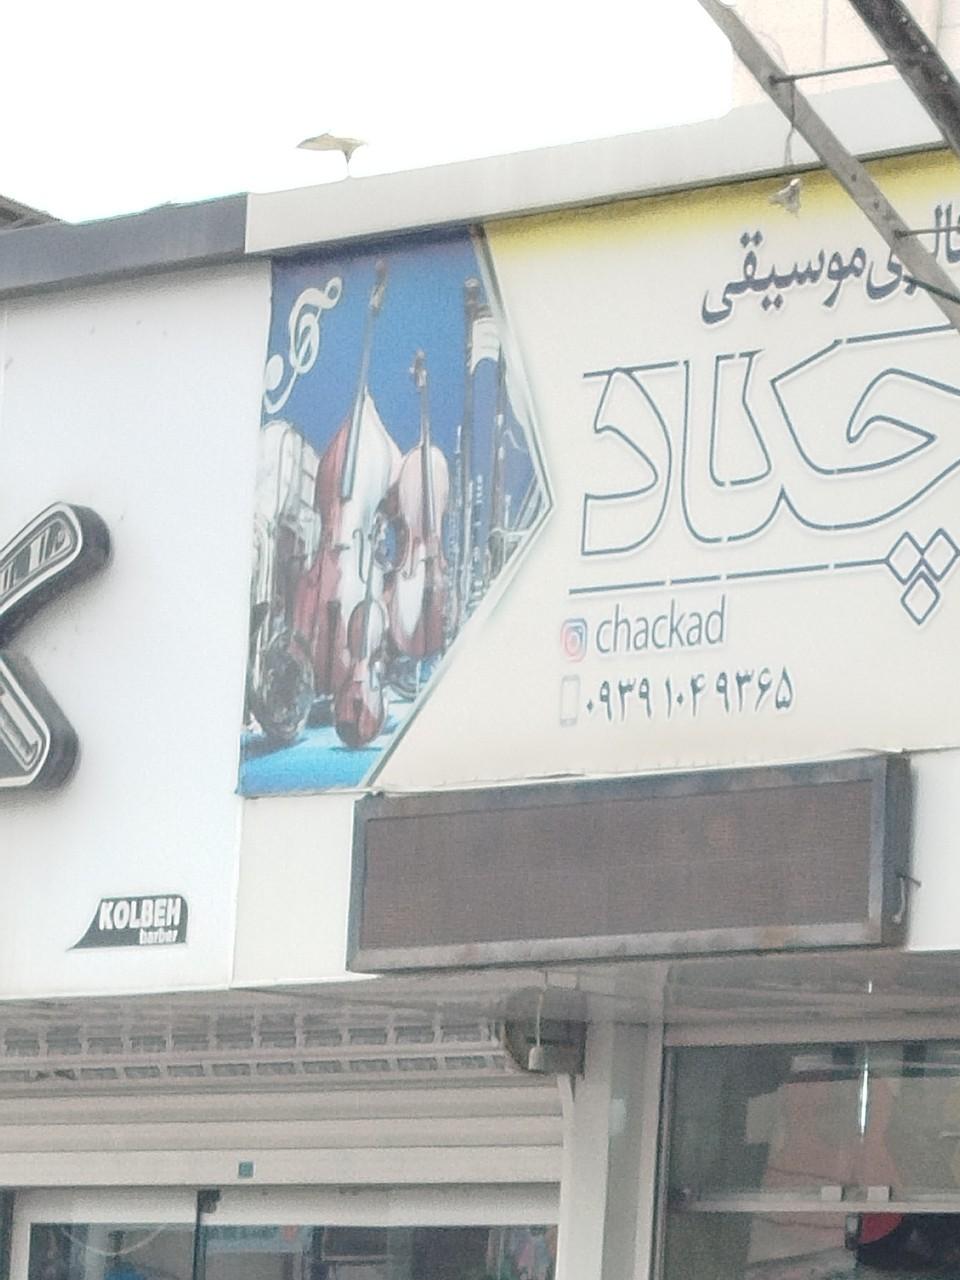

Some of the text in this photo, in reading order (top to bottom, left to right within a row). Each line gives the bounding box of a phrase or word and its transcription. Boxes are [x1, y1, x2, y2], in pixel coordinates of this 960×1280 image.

[701, 230, 867, 324] موسیقی
[596, 595, 727, 655] chackad
[98, 897, 182, 931] KOLBEH
